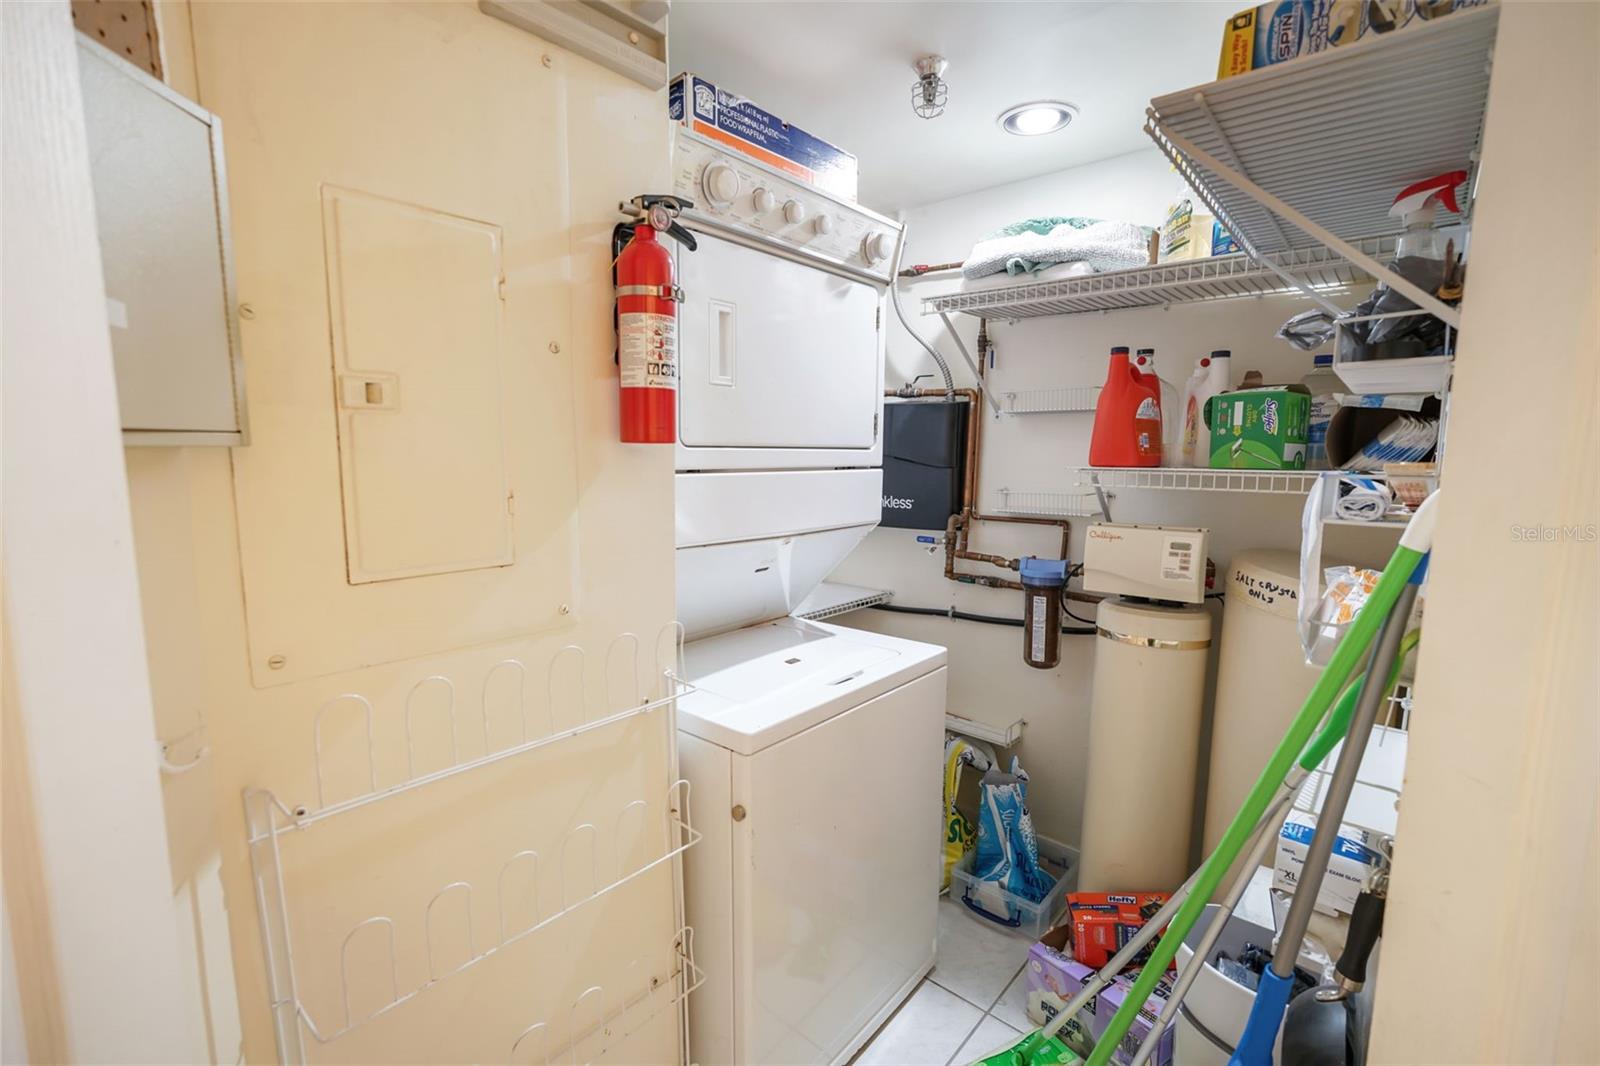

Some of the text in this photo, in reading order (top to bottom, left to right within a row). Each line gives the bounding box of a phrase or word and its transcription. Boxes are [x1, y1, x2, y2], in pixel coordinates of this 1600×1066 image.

[1280, 15, 1292, 58] SPIN
[719, 106, 780, 139] PROFESSIONAL PLASTIC
[719, 115, 738, 130] FOOD
[737, 122, 755, 136] WRAP
[1263, 398, 1277, 434] Swiffer
[1089, 530, 1122, 542] Culligan
[1235, 570, 1297, 599] SALT CRYSTA
[1248, 588, 1274, 604] ONLY
[1284, 870, 1297, 881] XL
[1328, 869, 1345, 878] EXAM
[1344, 874, 1361, 883] GLOV
[1108, 896, 1136, 904] Hefty
[1041, 1001, 1081, 1032] POER
[1046, 1015, 1075, 1041] FEX
